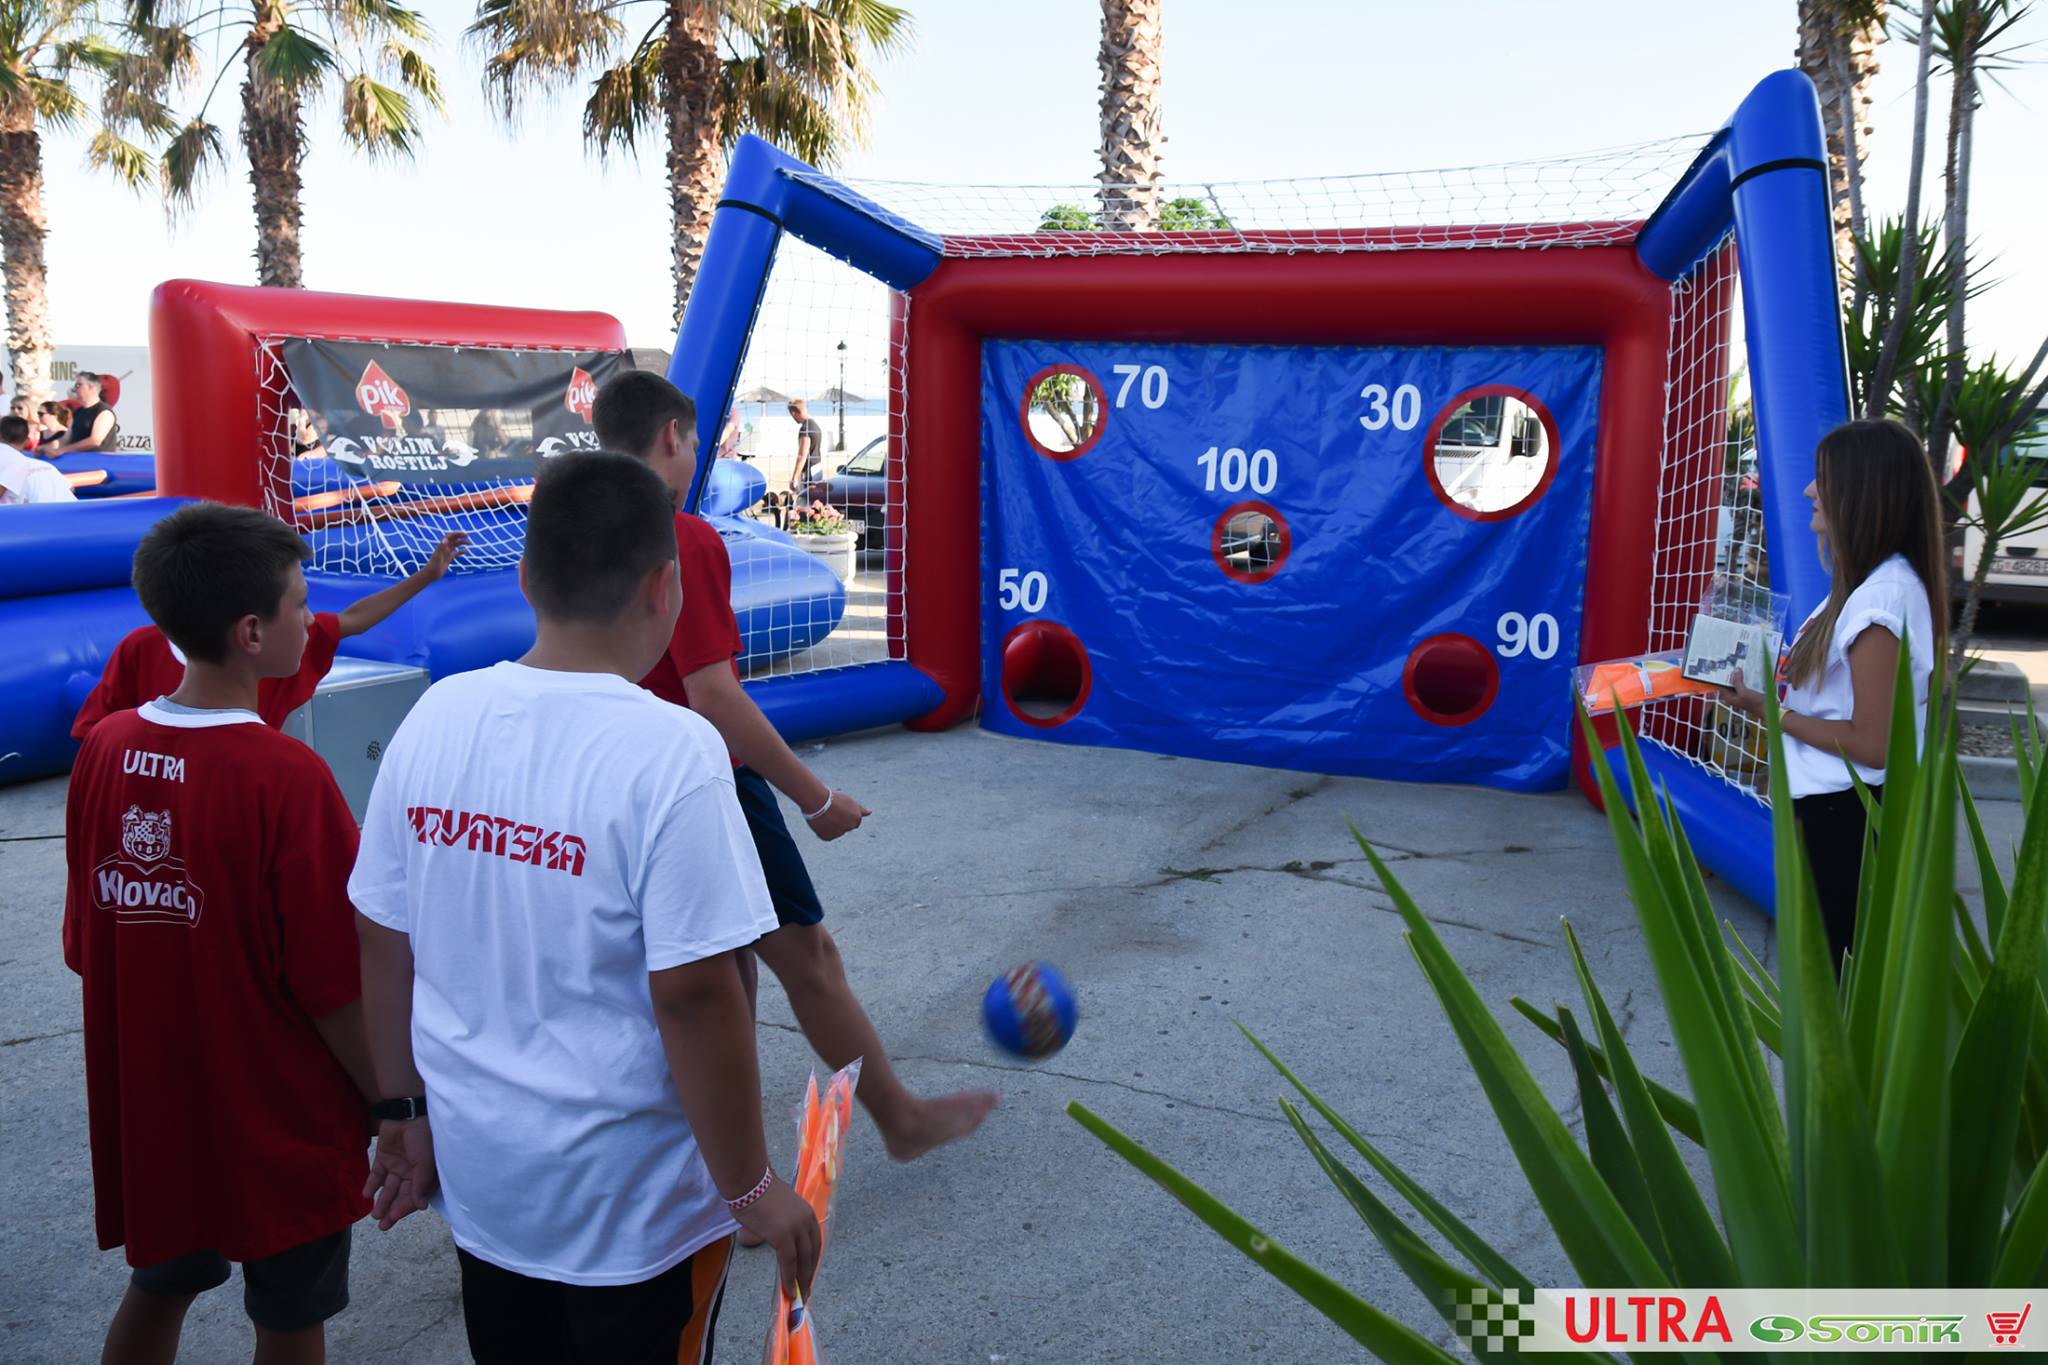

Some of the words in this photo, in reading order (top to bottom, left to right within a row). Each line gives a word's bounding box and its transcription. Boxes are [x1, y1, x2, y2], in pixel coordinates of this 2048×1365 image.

[1112, 364, 1169, 409] 70
[1359, 384, 1422, 431] 30
[1196, 446, 1278, 494] 100
[999, 568, 1048, 613] 50
[1496, 612, 1559, 659] 90
[123, 749, 185, 784] ULTRA
